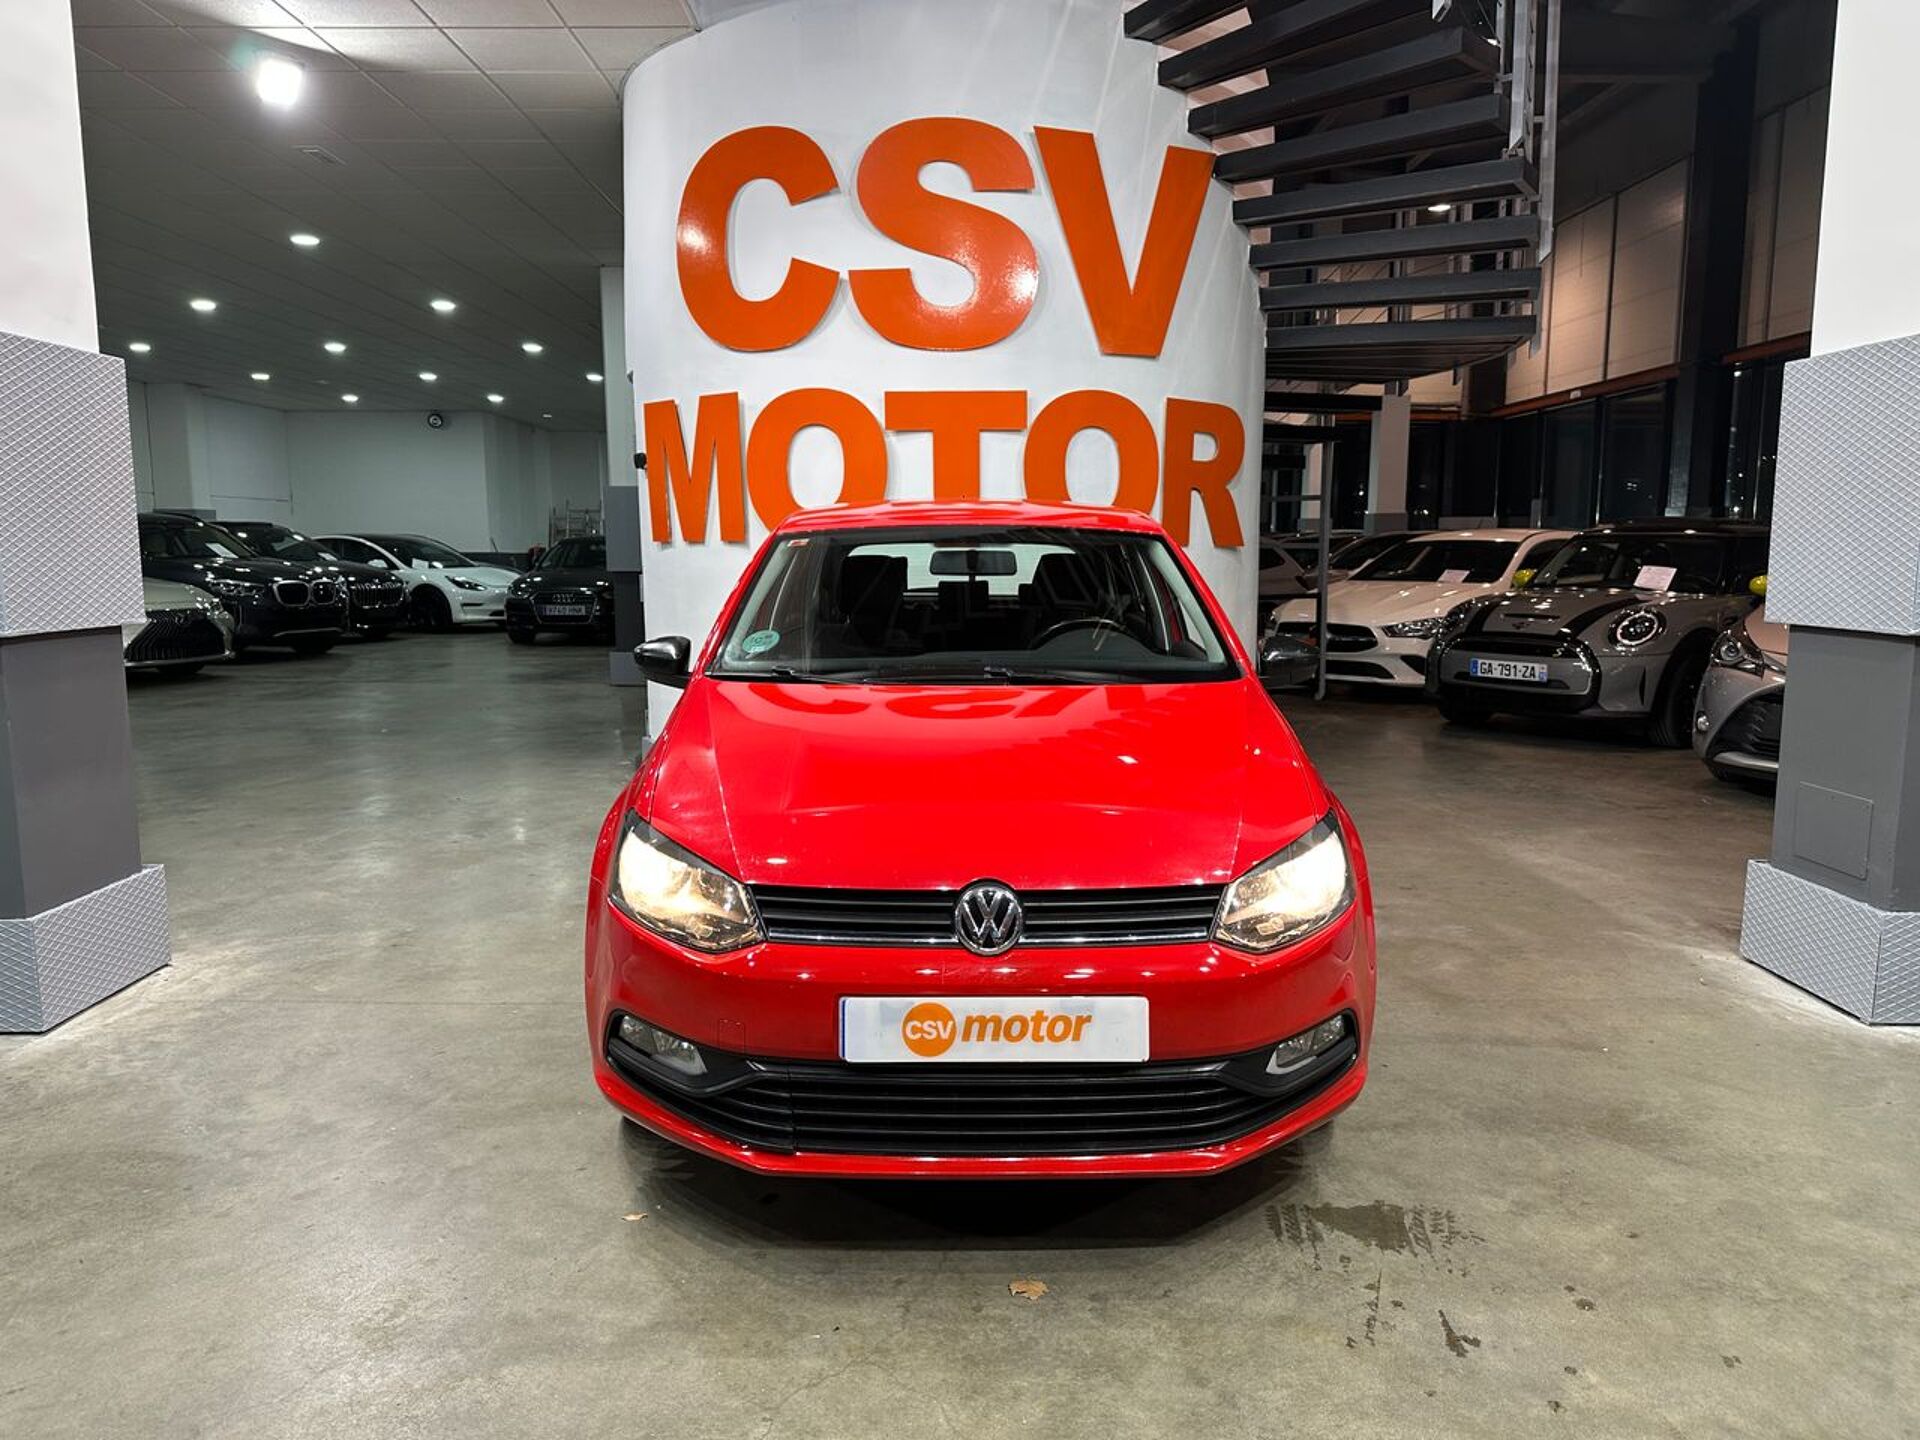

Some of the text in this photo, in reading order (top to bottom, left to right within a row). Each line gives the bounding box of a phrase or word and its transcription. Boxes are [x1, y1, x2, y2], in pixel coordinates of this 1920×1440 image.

[676, 117, 1215, 358] CSV
[643, 387, 1246, 548] MOTOR
[1480, 662, 1536, 679] GA-791-ZA
[961, 1010, 1092, 1043] motor
